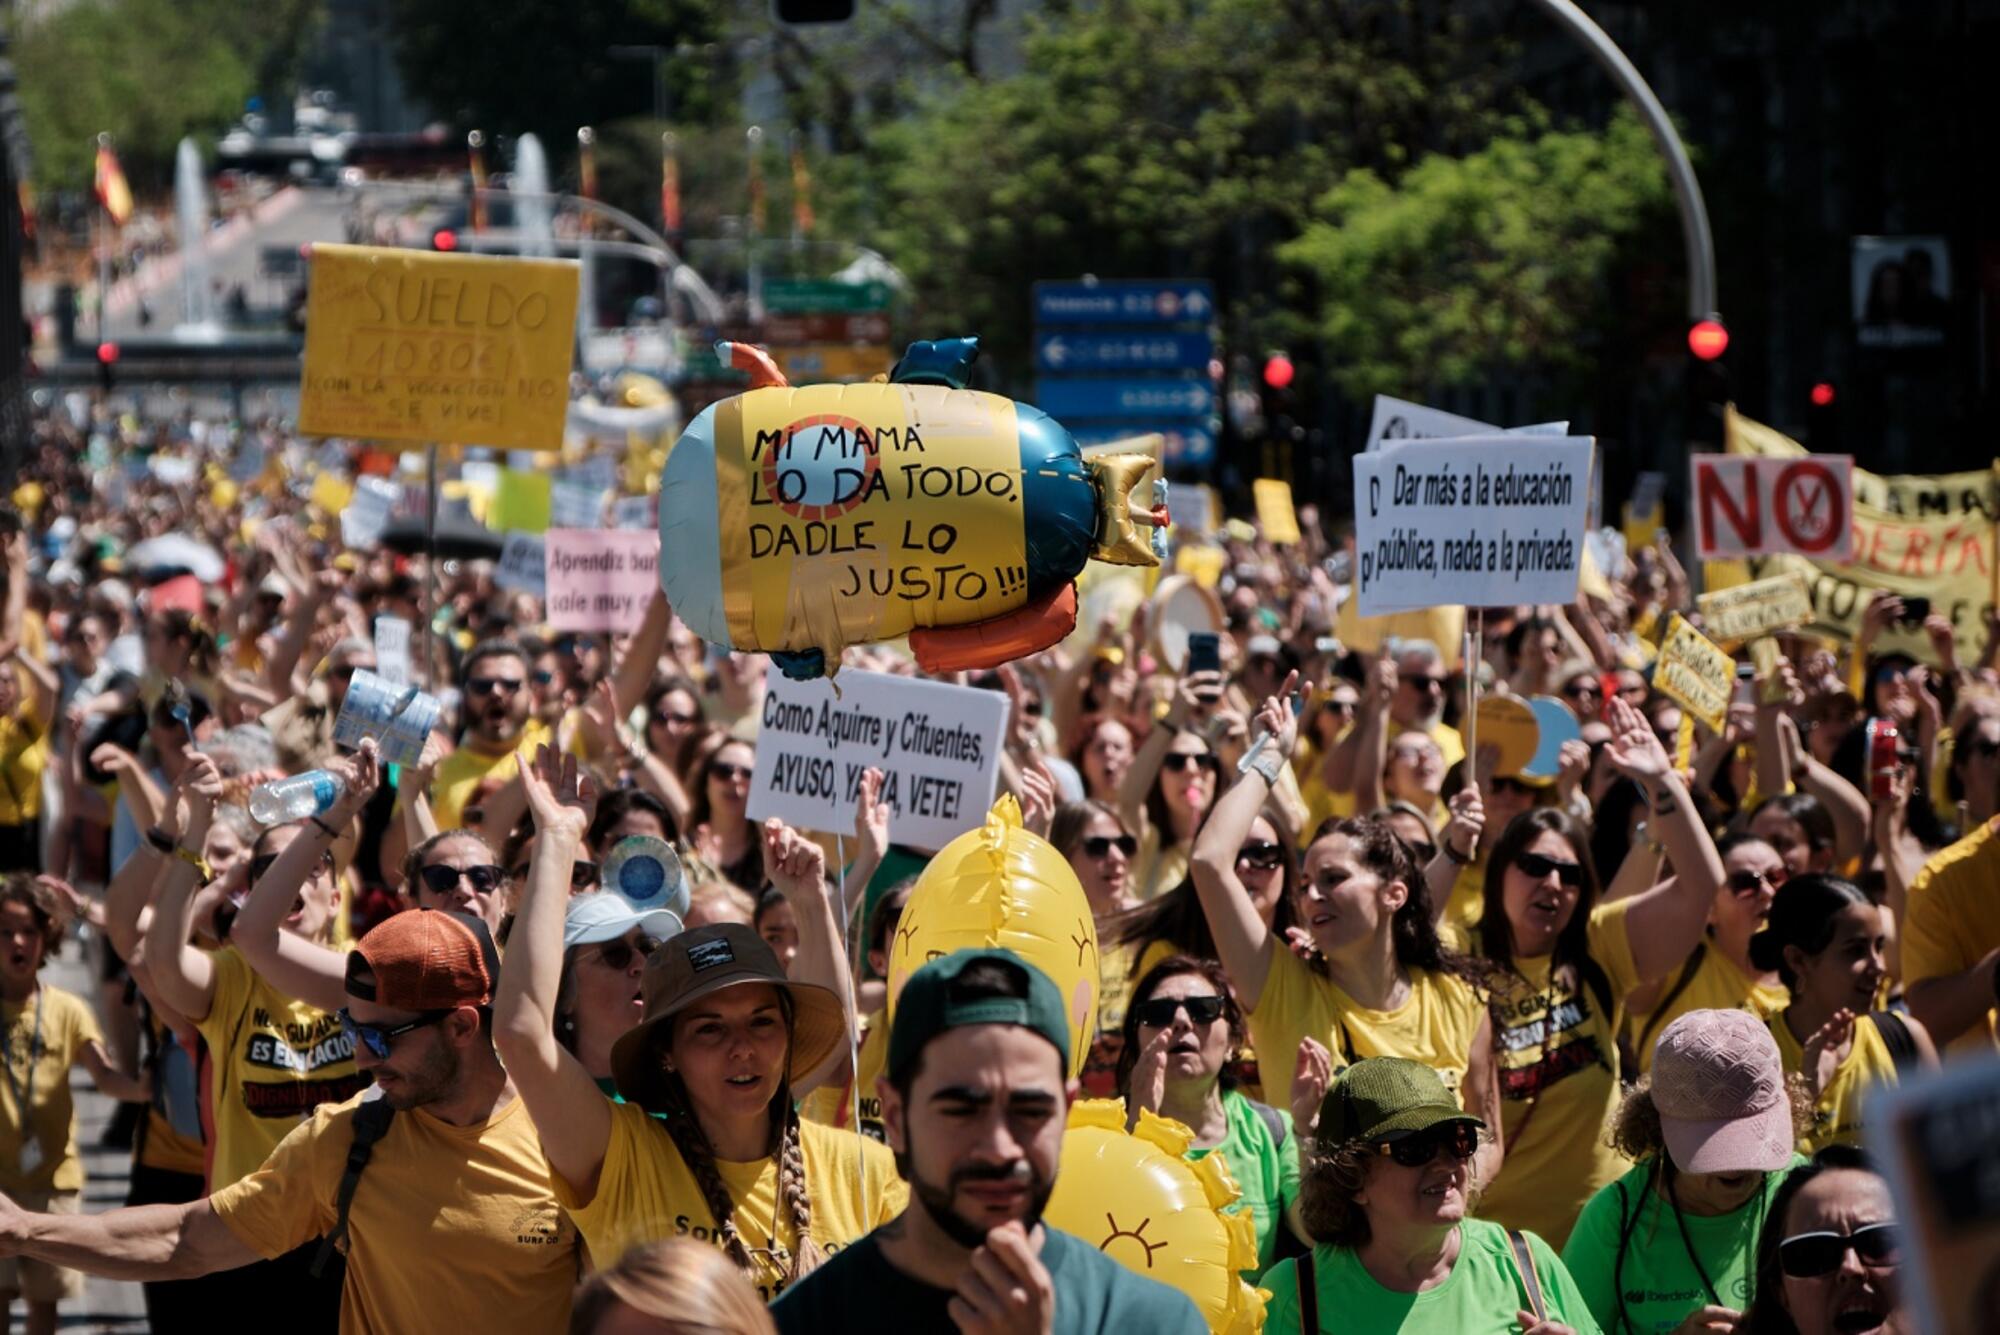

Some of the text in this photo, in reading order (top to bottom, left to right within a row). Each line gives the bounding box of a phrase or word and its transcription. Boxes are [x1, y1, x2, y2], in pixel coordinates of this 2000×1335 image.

[364, 268, 551, 331] SUELDO
[517, 379, 557, 396] NO
[751, 463, 1018, 506] LO DA TODO,
[1393, 463, 1421, 507] Dar
[1424, 462, 1458, 506] más
[1461, 473, 1473, 507] a
[1476, 463, 1490, 506] la
[1494, 461, 1573, 507] educación
[1697, 462, 1845, 554] NO
[749, 519, 958, 559] DADLE LO
[1376, 528, 1438, 581] pública,
[1442, 529, 1483, 573] nada
[1487, 540, 1497, 573] a
[1501, 528, 1514, 572] la
[1515, 528, 1576, 582] privada.
[551, 548, 623, 577] Aprendiz
[592, 596, 632, 616] muy
[763, 689, 984, 771] Como Aguirre y Cifuentes,
[769, 752, 837, 807] AYUSO,
[909, 773, 964, 820] VETE!
[251, 1040, 272, 1061] ES
[859, 1097, 882, 1118] NO
